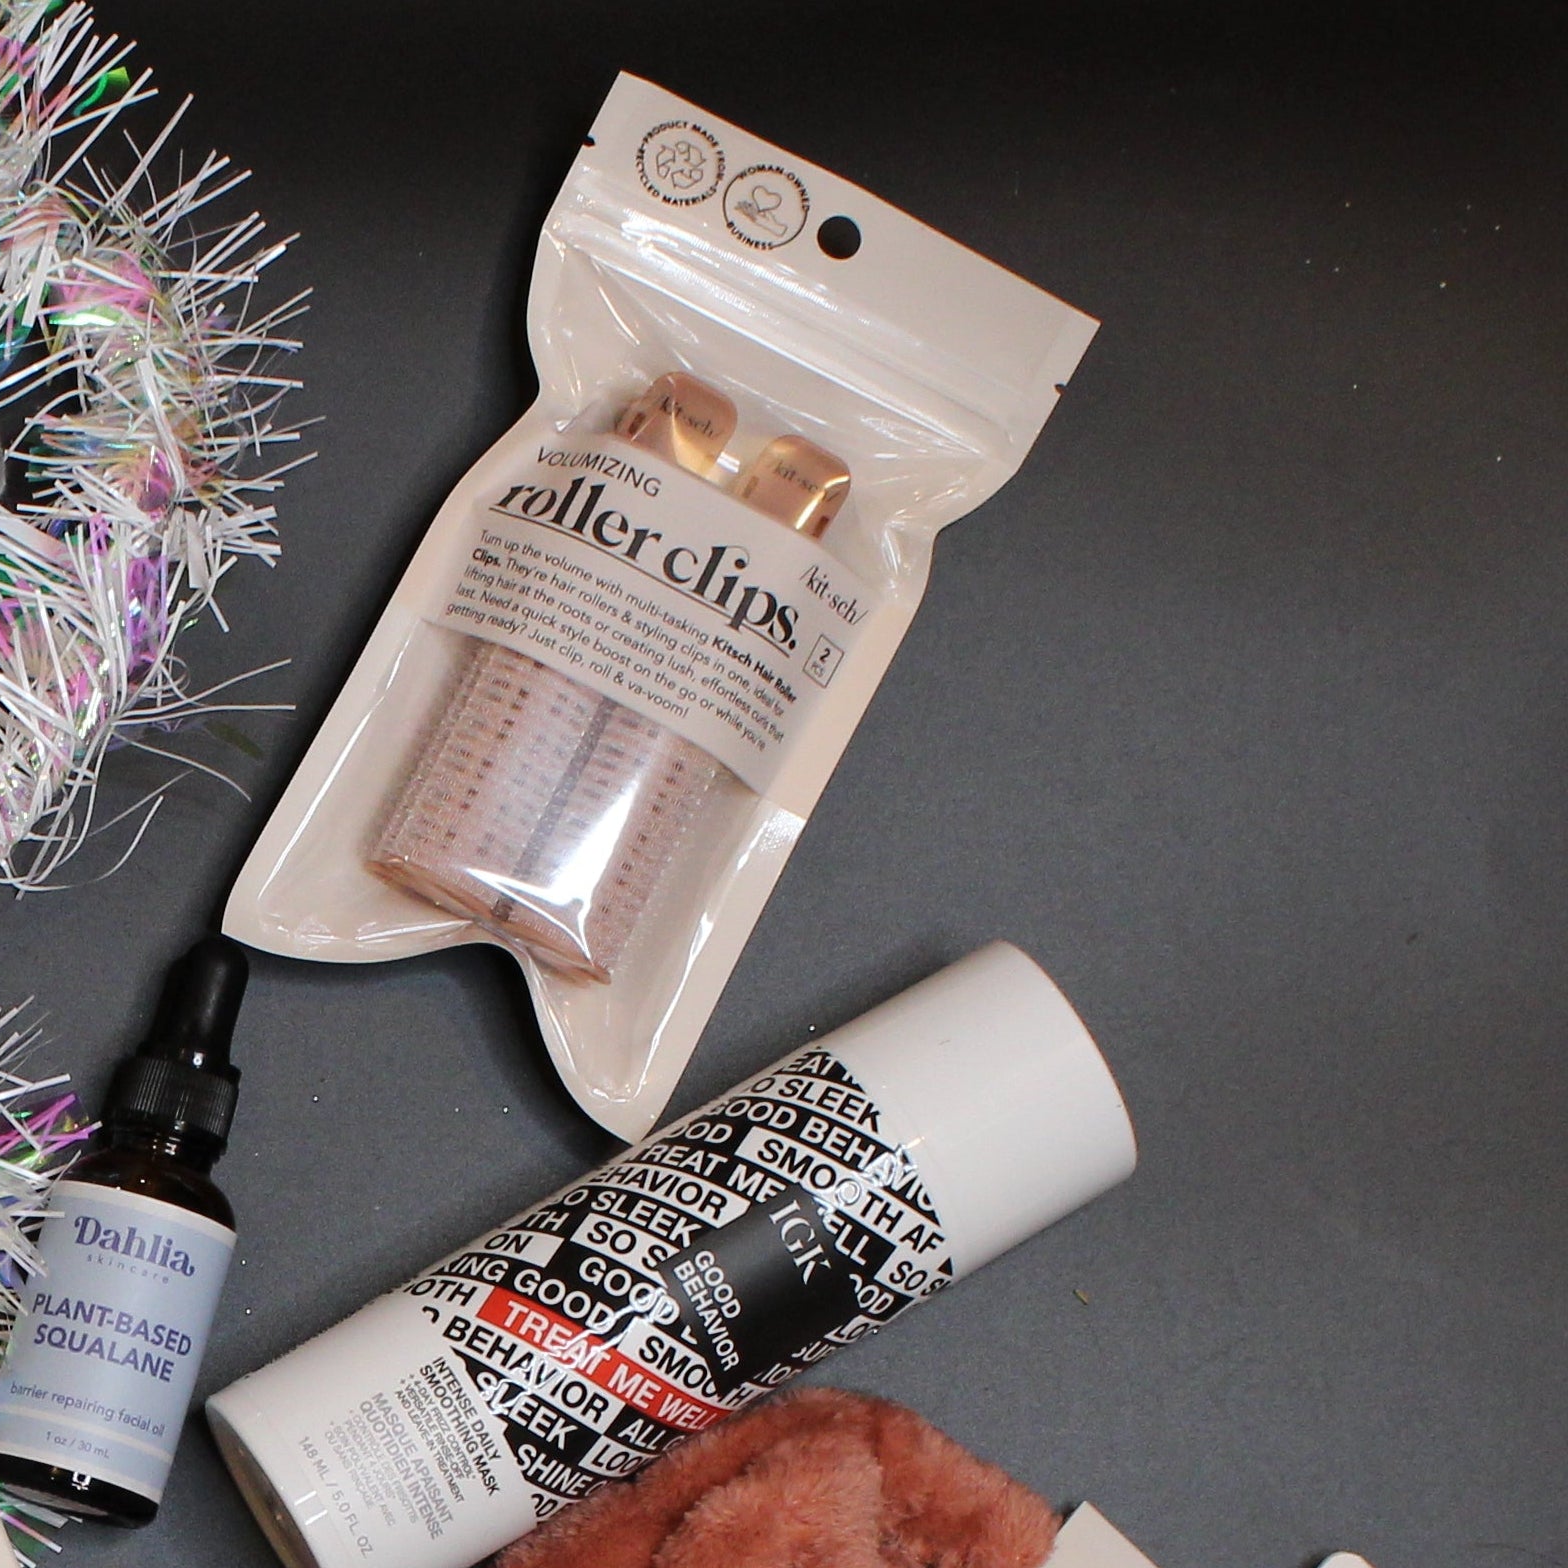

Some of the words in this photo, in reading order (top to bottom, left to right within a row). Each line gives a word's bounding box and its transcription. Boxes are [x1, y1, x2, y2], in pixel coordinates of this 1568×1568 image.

[538, 448, 660, 496] VOLUMIZING
[497, 476, 662, 560] roller
[663, 546, 798, 650] clips.
[819, 647, 831, 663] 2
[74, 1216, 194, 1276] Dahlia
[86, 1252, 168, 1284] skincare
[770, 1200, 830, 1284] IGK
[674, 1260, 738, 1370] BEHAVIOR
[695, 1251, 742, 1320] GOOD
[32, 1293, 191, 1356] PLANT-BASED
[34, 1324, 174, 1382] SQUALANE
[505, 1301, 610, 1374] TREAT
[608, 1364, 661, 1408] ME
[9, 1380, 49, 1399] barrier
[51, 1393, 114, 1421] repairing
[118, 1408, 152, 1433] facial
[151, 1423, 166, 1438] oil
[420, 1365, 478, 1454] SMOOTHING
[473, 1455, 499, 1496] MASK
[433, 1357, 476, 1417] INTENSE
[472, 1420, 501, 1460] DAILY
[46, 1431, 52, 1441] 1
[53, 1435, 68, 1446] oz
[77, 1439, 93, 1453] 30
[93, 1447, 110, 1460] mL
